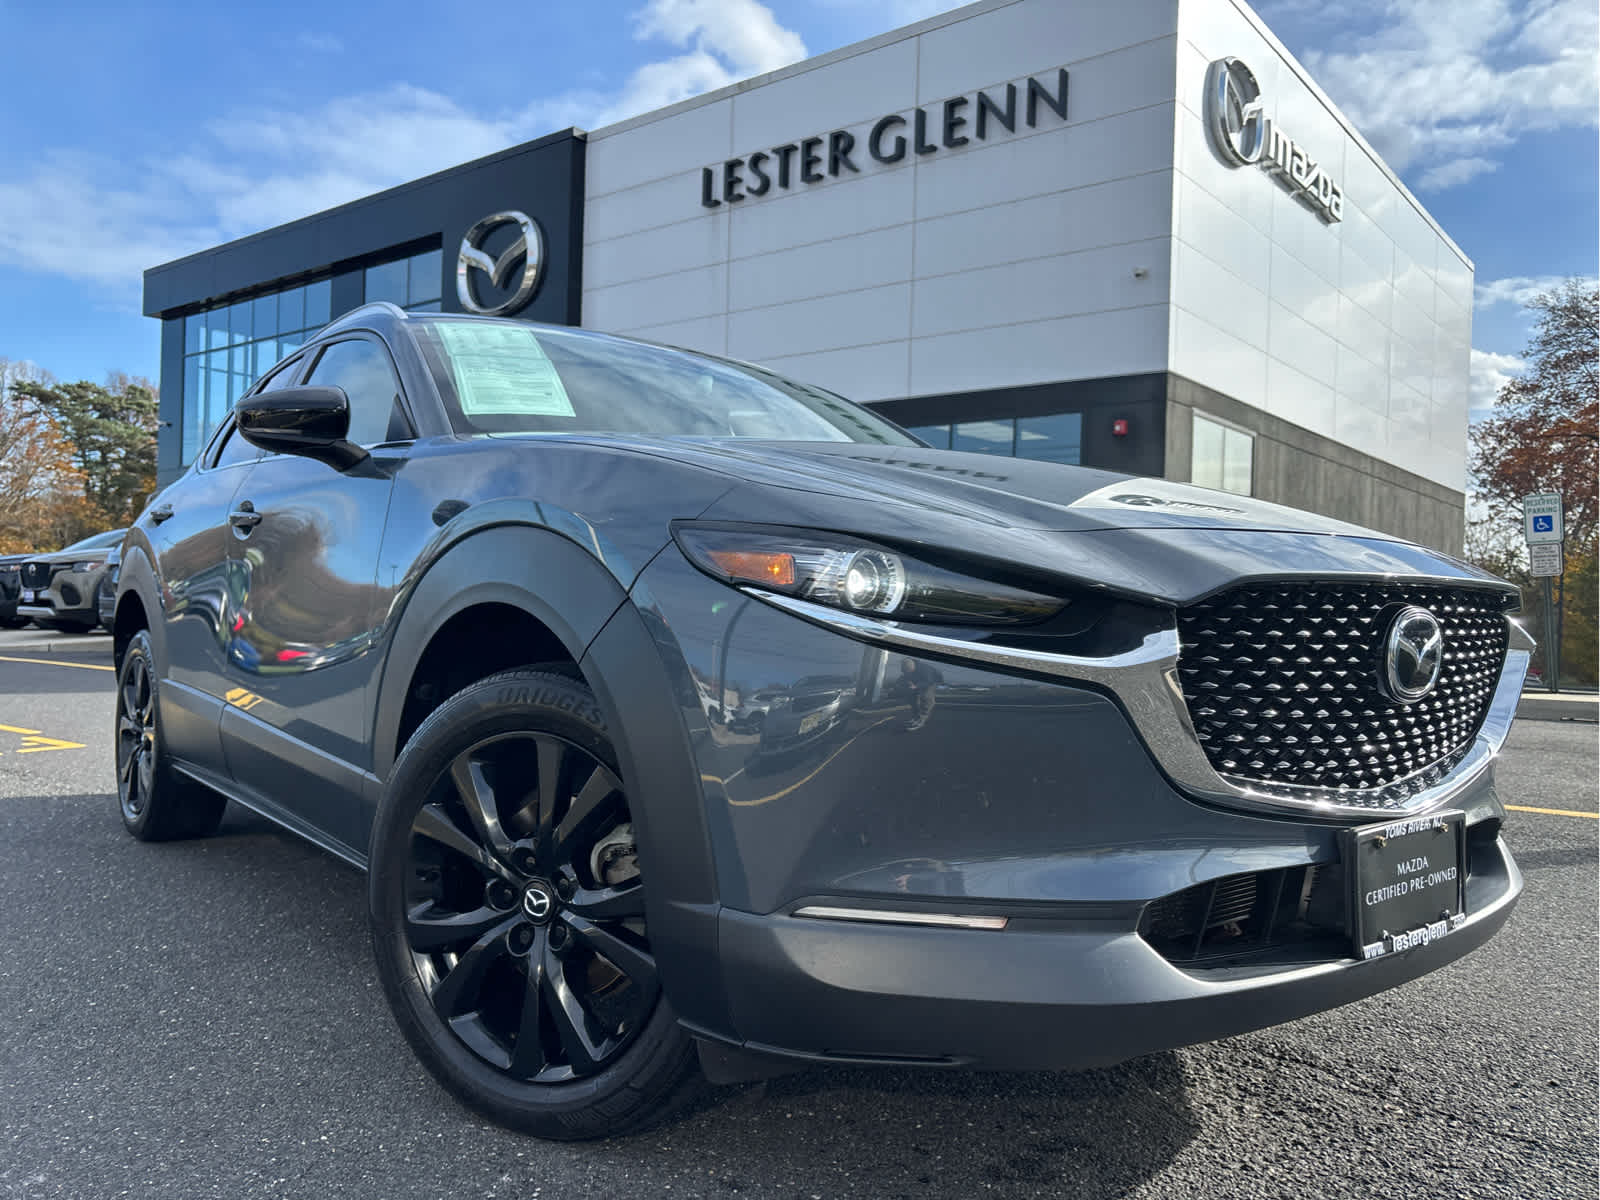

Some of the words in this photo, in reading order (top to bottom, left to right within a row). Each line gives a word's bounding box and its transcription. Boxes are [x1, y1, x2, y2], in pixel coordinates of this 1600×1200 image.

[702, 130, 860, 208] LESTER
[868, 68, 1070, 164] GLENN
[1261, 118, 1343, 224] mazda
[1385, 822, 1408, 840] TOMS
[1397, 856, 1429, 876] MAZDA
[1366, 881, 1408, 906] CERTIFIED
[1410, 867, 1457, 892] PRE-OWNED
